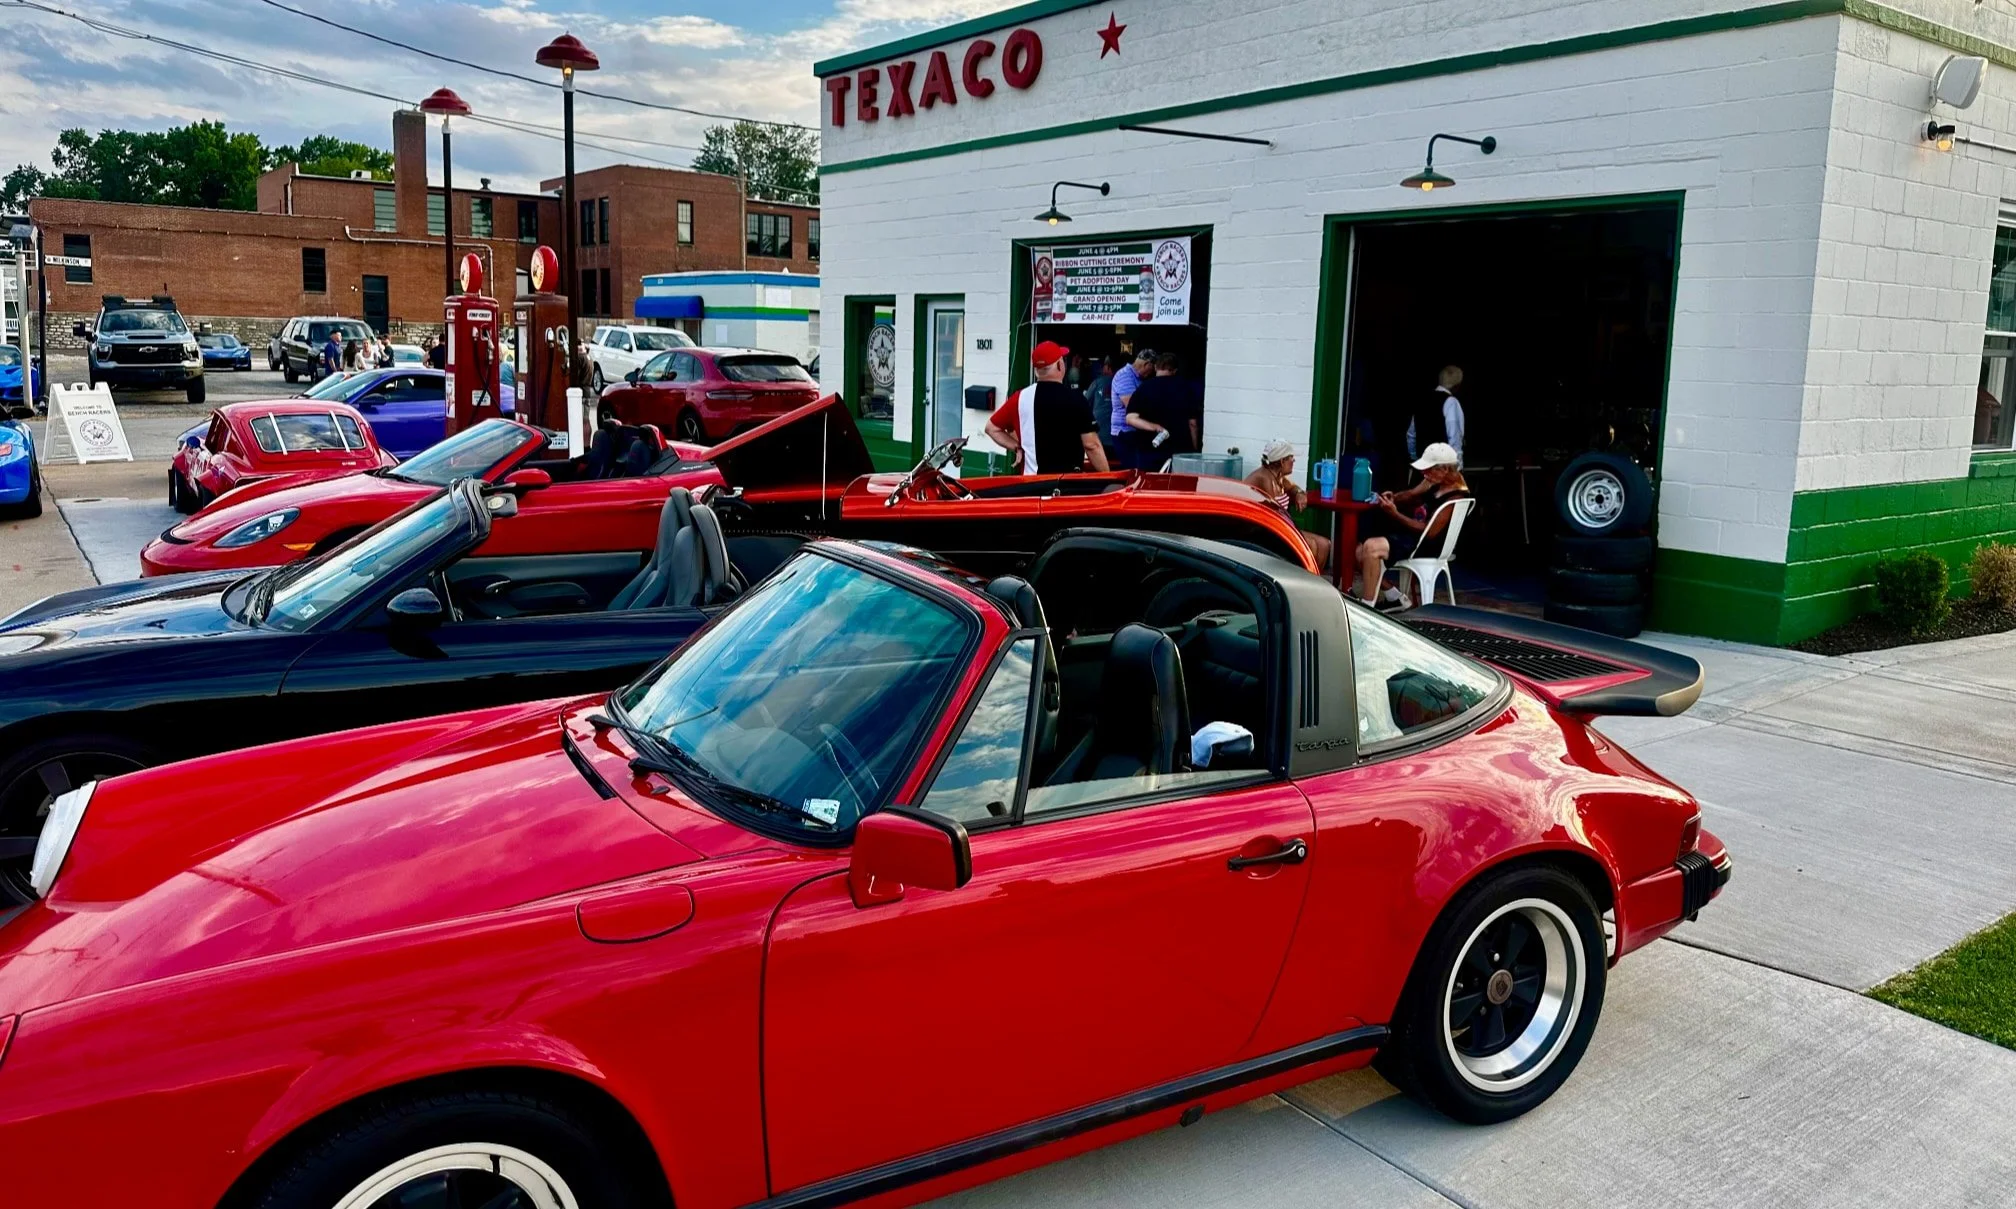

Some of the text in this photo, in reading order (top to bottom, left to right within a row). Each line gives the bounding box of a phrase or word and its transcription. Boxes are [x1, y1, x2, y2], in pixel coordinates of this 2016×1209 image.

[826, 28, 1043, 128] TEXACO
[1078, 247, 1093, 255] JUNE
[1106, 246, 1119, 254] 4PM
[1055, 256, 1145, 267] RIBBON CUTTING CEREMONY
[1078, 267, 1092, 275] JUNE
[1160, 296, 1181, 306] Come
[1156, 306, 1185, 318] join us!
[976, 339, 993, 350] 1801
